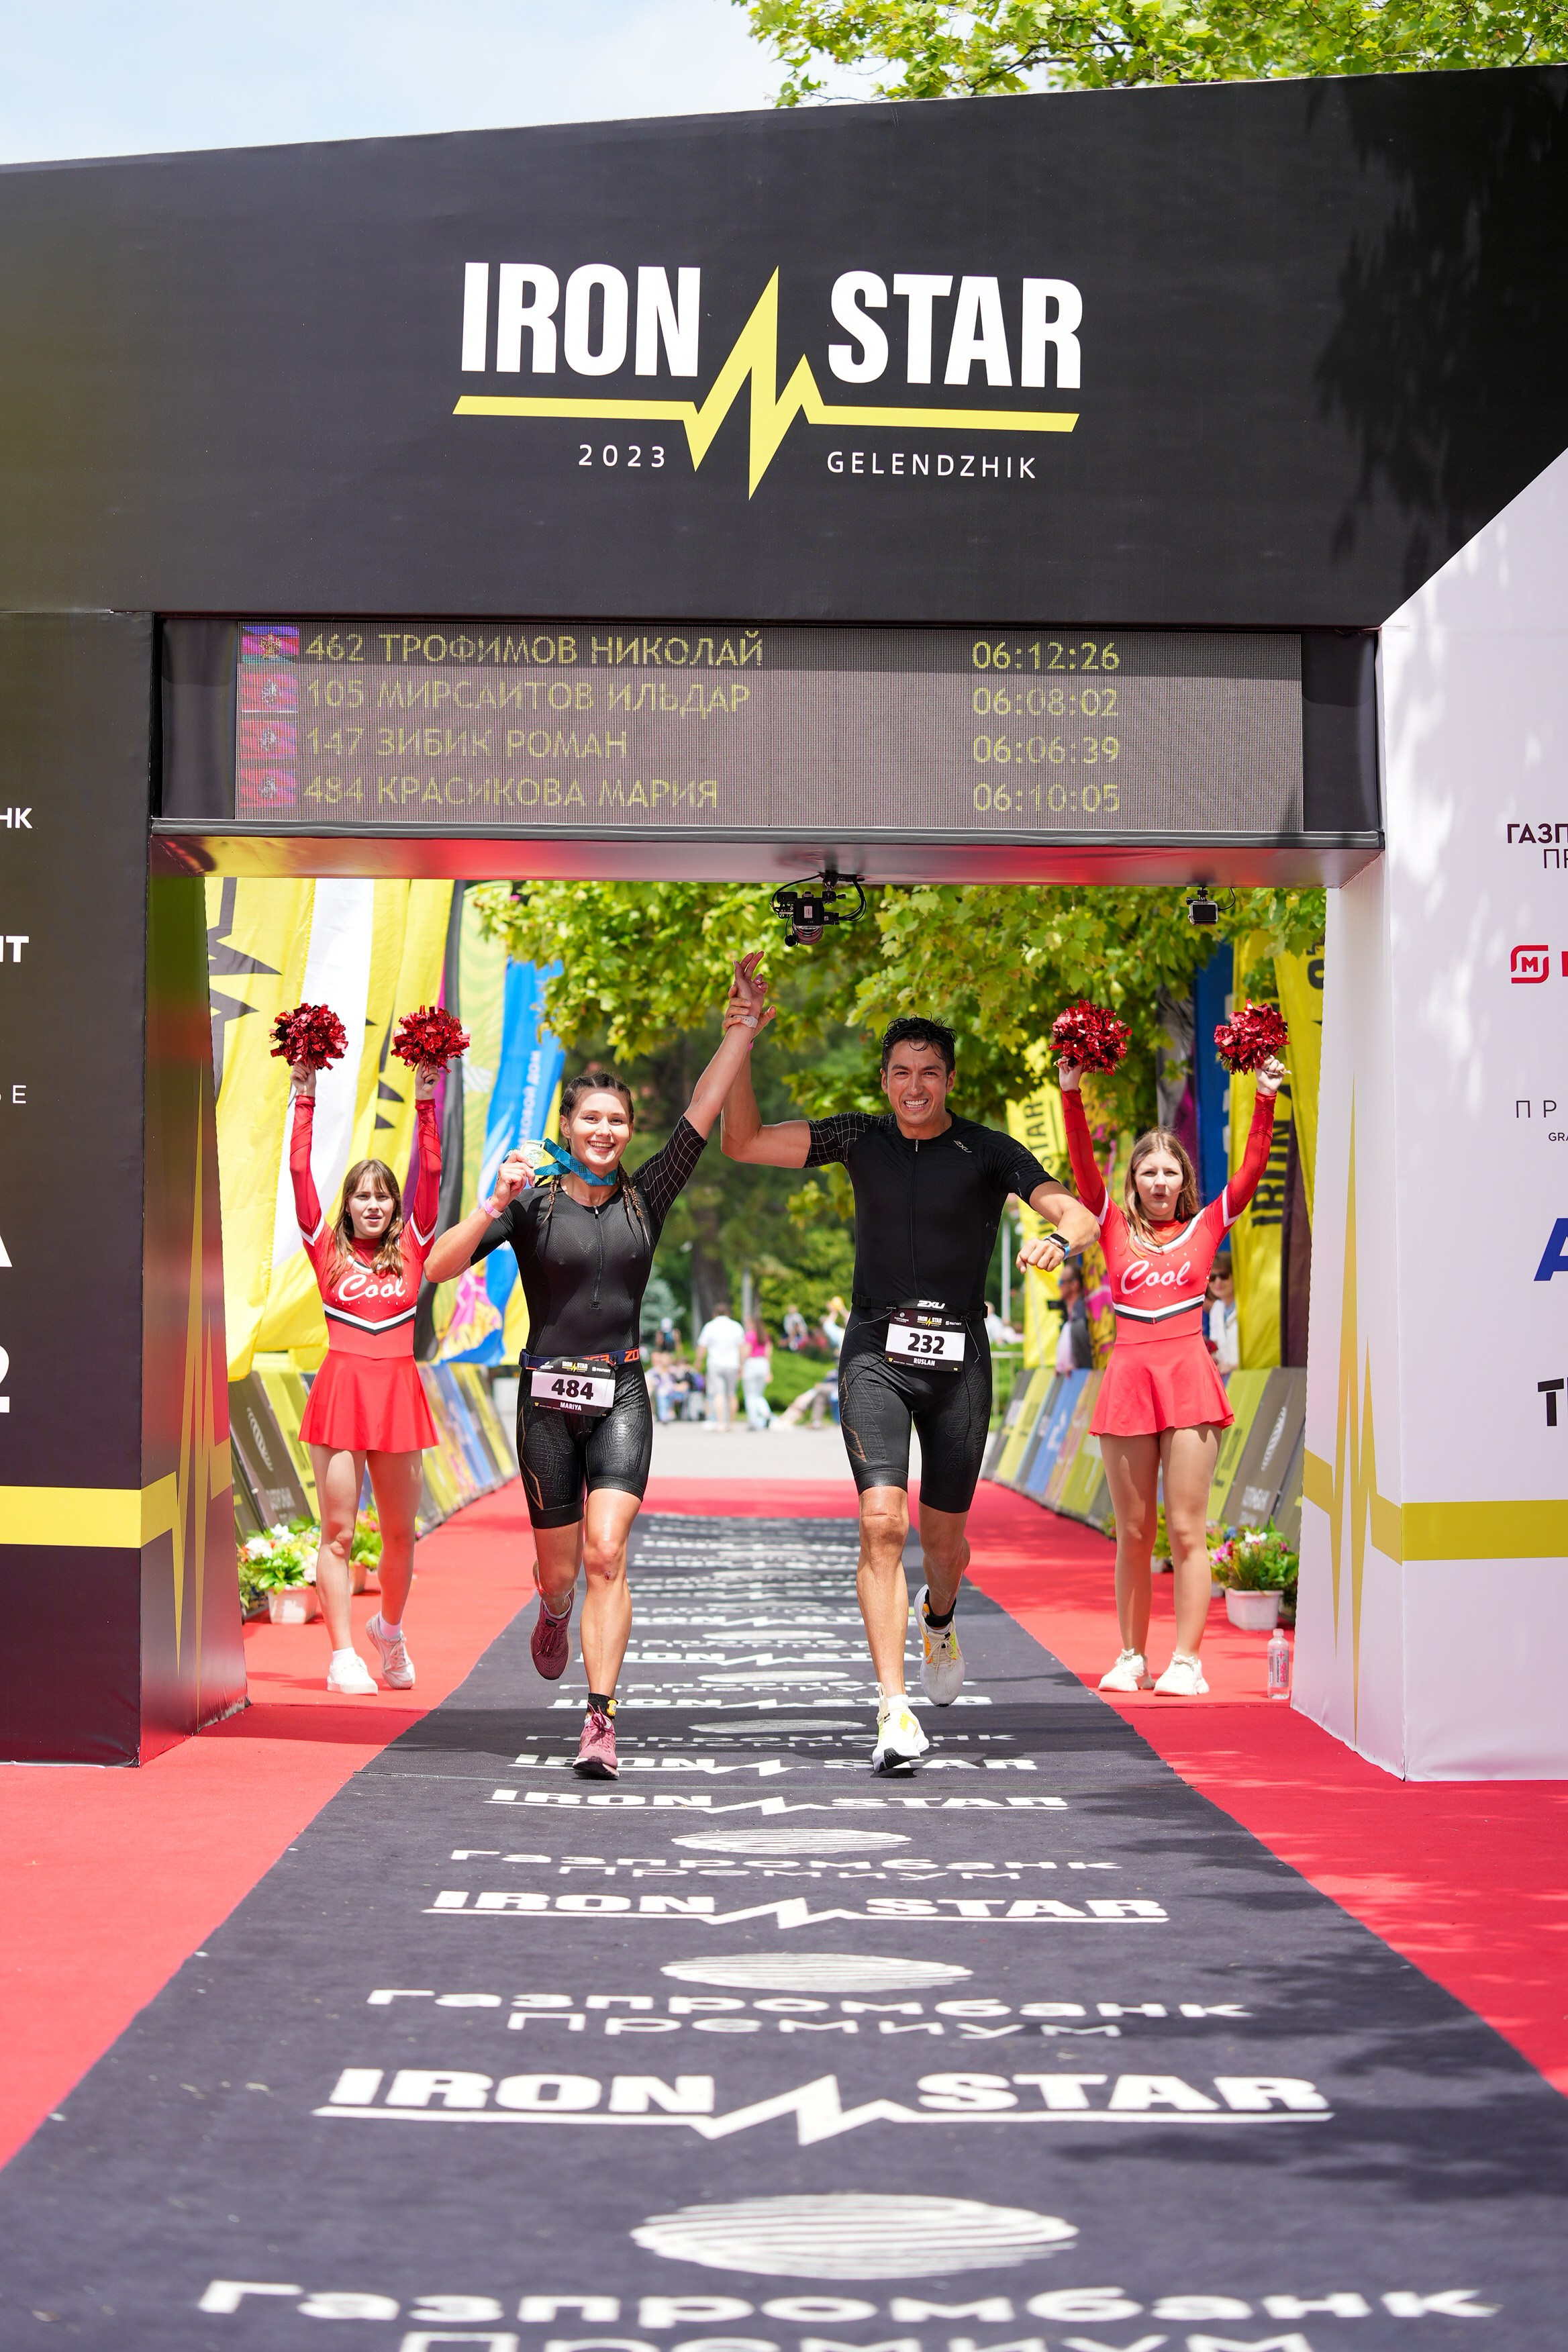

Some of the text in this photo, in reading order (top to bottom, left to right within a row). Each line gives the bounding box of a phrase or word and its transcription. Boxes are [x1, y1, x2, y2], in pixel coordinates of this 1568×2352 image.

[461, 261, 1083, 389] IRON STAR
[577, 444, 1036, 479] 2023 GELENDZHIK
[305, 630, 1120, 670] 462 ТРОФИМОВ НИКОЛАЙ 06:12:26
[307, 679, 363, 707] 105
[608, 683, 750, 720] ИЛЬДАР
[973, 687, 1119, 716] 06:08:02
[308, 727, 1120, 764] 147 ЗИБИК РОМАН 06:06:39
[305, 776, 1120, 812] 484 КРАСИКОВА МАРИЯ 06:10:05
[0, 936, 29, 963] Т
[953, 1140, 972, 1153] 2XU
[338, 1274, 406, 1302] Cool
[1120, 1260, 1191, 1295] Cool
[917, 1300, 946, 1310] 2XU
[908, 1332, 945, 1355] 232
[913, 1357, 936, 1367] RUSLAN
[551, 1379, 594, 1400] 484
[560, 1402, 582, 1412] MARIYA
[491, 1789, 1069, 1808] IRON STAR
[450, 1849, 1122, 1869] Газпромбанк
[557, 1866, 1022, 1881] Премиум
[434, 1890, 1167, 1917] IRON STAR
[366, 1989, 1254, 2018] Газпромбанк
[507, 2012, 1121, 2039] Премиум
[329, 2068, 1331, 2113] IRON STAR
[197, 2278, 1504, 2330] Газпромбанк
